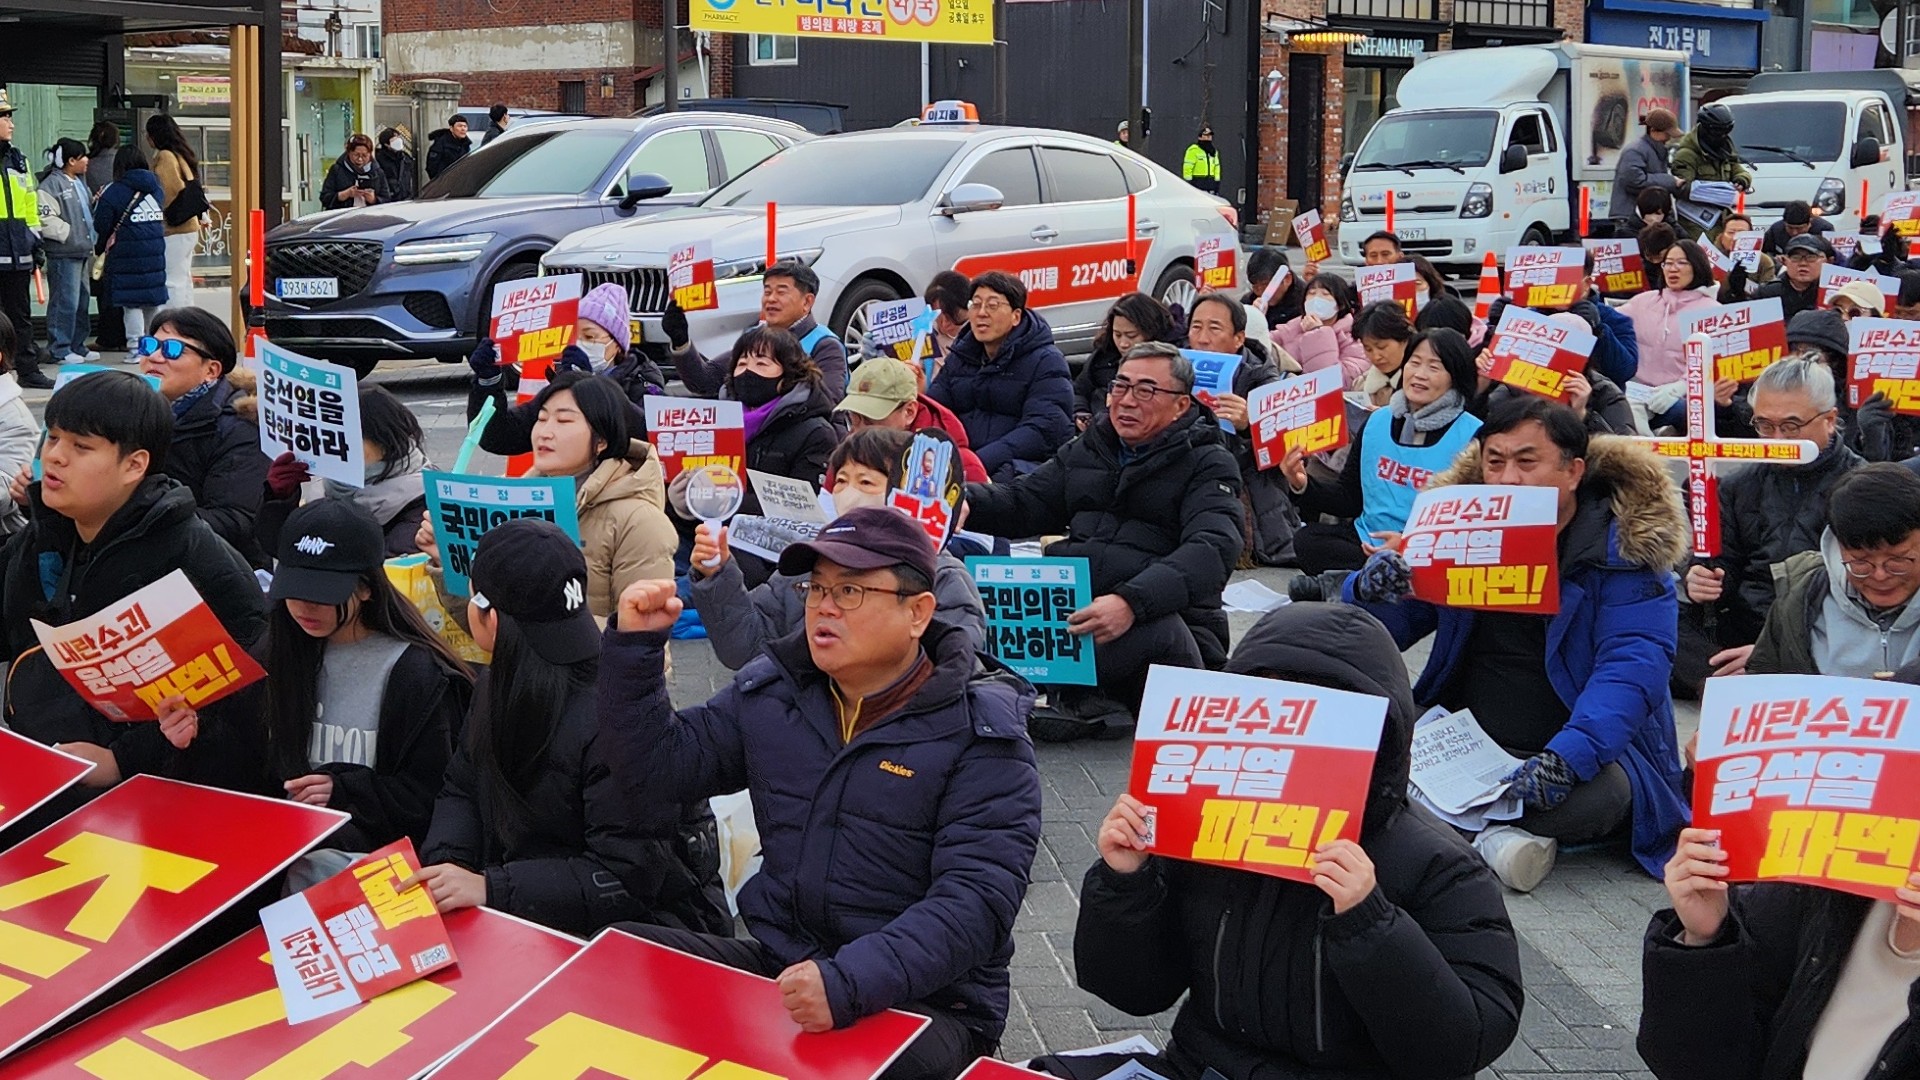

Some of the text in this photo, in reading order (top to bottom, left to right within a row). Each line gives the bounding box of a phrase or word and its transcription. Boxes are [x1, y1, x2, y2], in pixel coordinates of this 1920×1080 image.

[703, 12, 738, 22] PHARMACY
[801, 17, 883, 35] 병의원 처방 조제
[949, 12, 969, 25] 공휴일
[1400, 38, 1424, 57] HAIR
[1648, 26, 1712, 57] 전자담배
[928, 110, 959, 121] 이지콜
[1399, 229, 1420, 239] 2967
[1020, 258, 1128, 292] 이지콜 227-000
[1512, 251, 1562, 268] 내란수괴
[310, 281, 334, 295] 5621
[501, 282, 557, 310] 내란수괴
[1526, 284, 1577, 307] 파면!
[1605, 270, 1643, 292] 파면!
[495, 305, 552, 339] 윤석열
[872, 304, 909, 326] 내란공범
[1505, 317, 1569, 344] 내란수괴
[1690, 307, 1750, 336] 내란수괴
[517, 324, 573, 362] 파면!
[872, 321, 916, 347] 국민의
[1502, 359, 1567, 398] 파면!
[1716, 346, 1783, 383] 파면!
[263, 369, 345, 427] 윤석열을
[1258, 378, 1318, 416] 내란수괴
[657, 406, 717, 428] 내란수괴
[1258, 400, 1317, 444] 윤석열
[1283, 414, 1342, 453] 파면!
[264, 406, 350, 463] 탄핵하라
[656, 430, 716, 457] 윤석열
[1416, 495, 1513, 527] 내란수괴
[1405, 529, 1503, 567] 윤석열
[980, 568, 1069, 579] 위헌정당
[1446, 565, 1548, 606] 파면!
[977, 585, 1076, 622] 국민의힘
[52, 601, 152, 664] 내란수괴
[74, 636, 177, 696] 윤석열
[1164, 695, 1318, 737] 내란수괴
[1724, 696, 1910, 747] 내란수괴
[879, 760, 915, 778] Dickies
[1147, 743, 1295, 799] 윤석열
[1710, 750, 1885, 816] 윤석열
[1191, 798, 1350, 869] 파면!
[1757, 810, 1920, 889] 파면
[352, 850, 438, 931] 파면!
[324, 903, 402, 984] 윤석열
[280, 926, 346, 1000] 내란수괴
